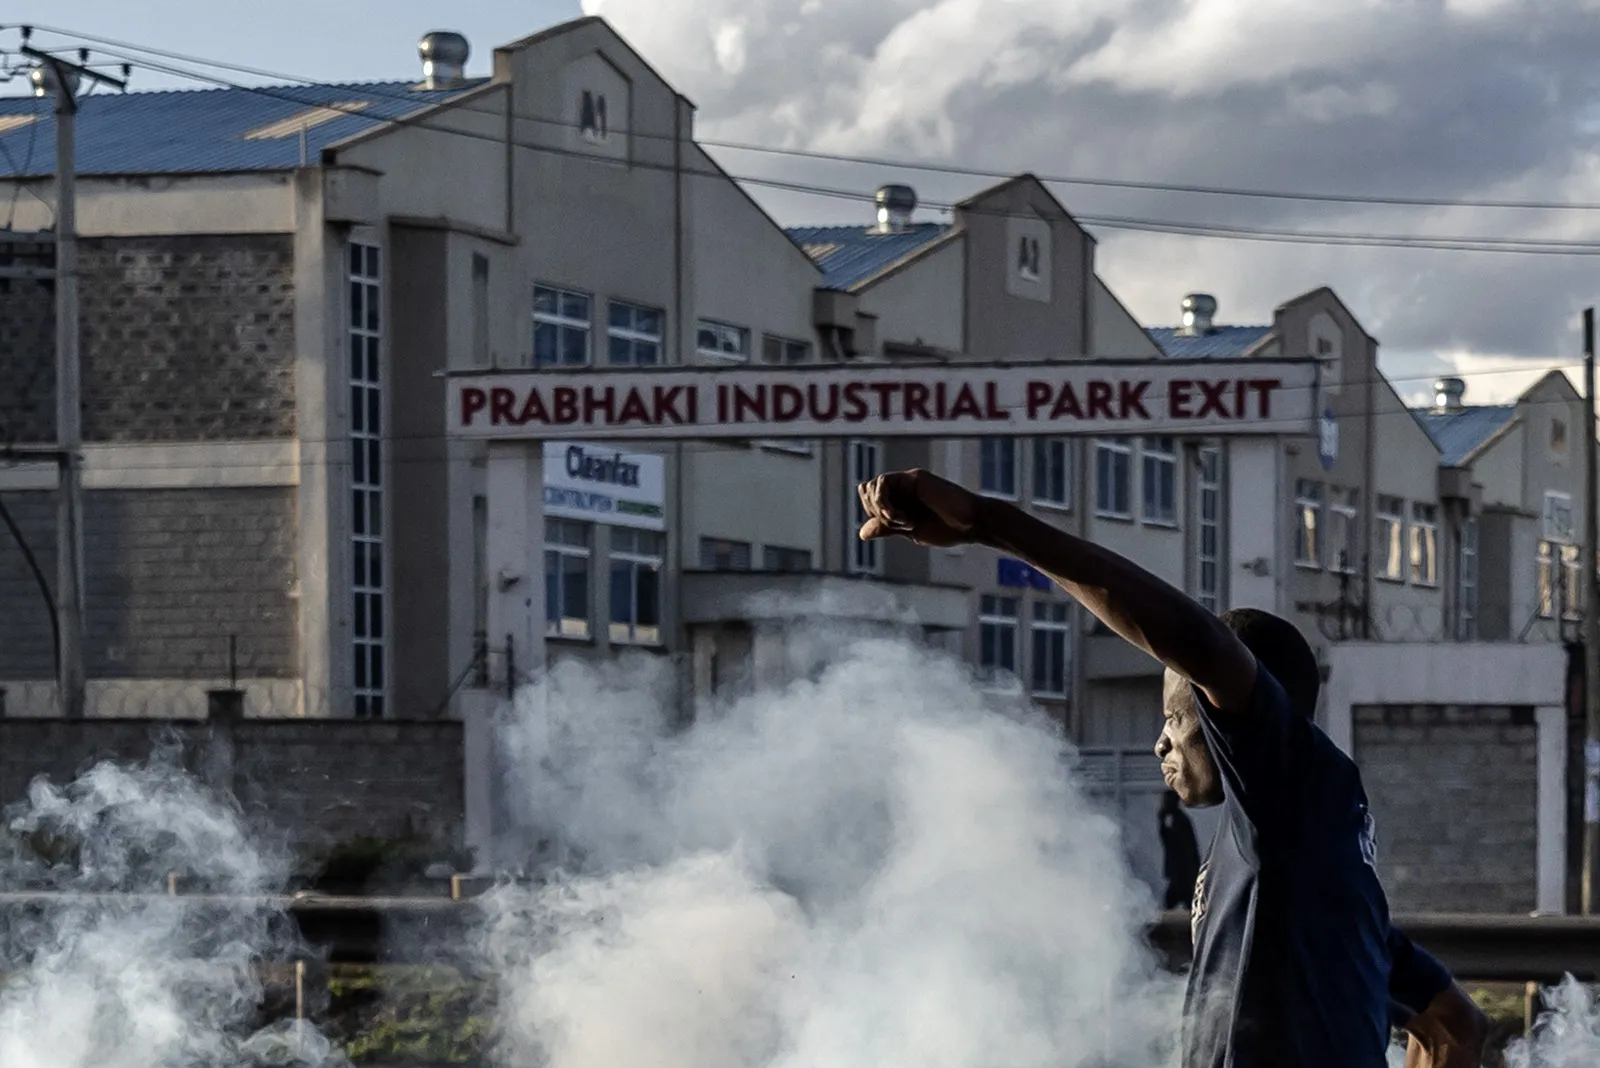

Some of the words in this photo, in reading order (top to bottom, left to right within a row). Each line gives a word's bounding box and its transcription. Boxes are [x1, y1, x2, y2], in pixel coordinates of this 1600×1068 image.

[460, 385, 698, 426] PRABHAKI
[717, 382, 1011, 422] INDUSTRIAL
[1025, 380, 1152, 421] PARK
[1168, 378, 1282, 420] EXIT
